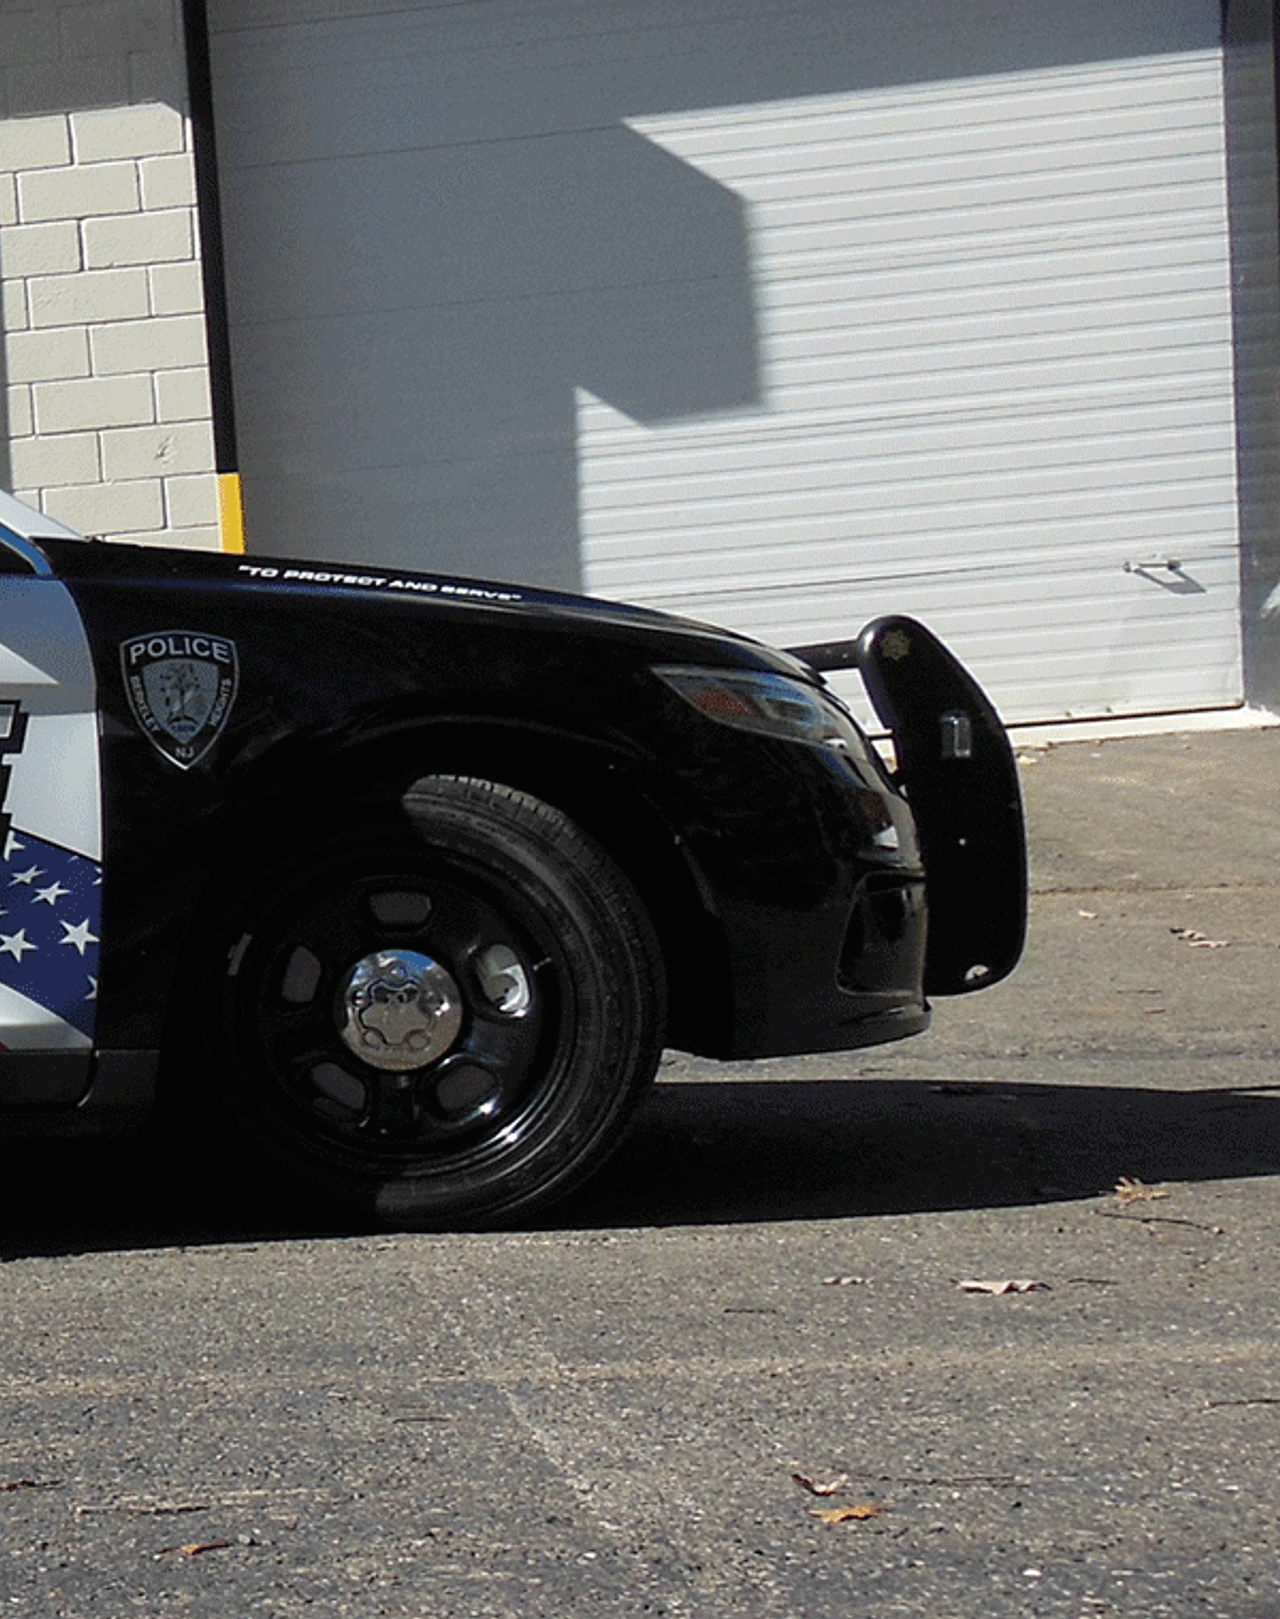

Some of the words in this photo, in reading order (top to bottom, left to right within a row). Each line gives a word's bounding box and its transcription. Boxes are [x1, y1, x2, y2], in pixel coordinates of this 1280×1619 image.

[283, 569, 387, 587] PROTECT
[388, 579, 438, 592] AND
[130, 637, 230, 664] POLICE
